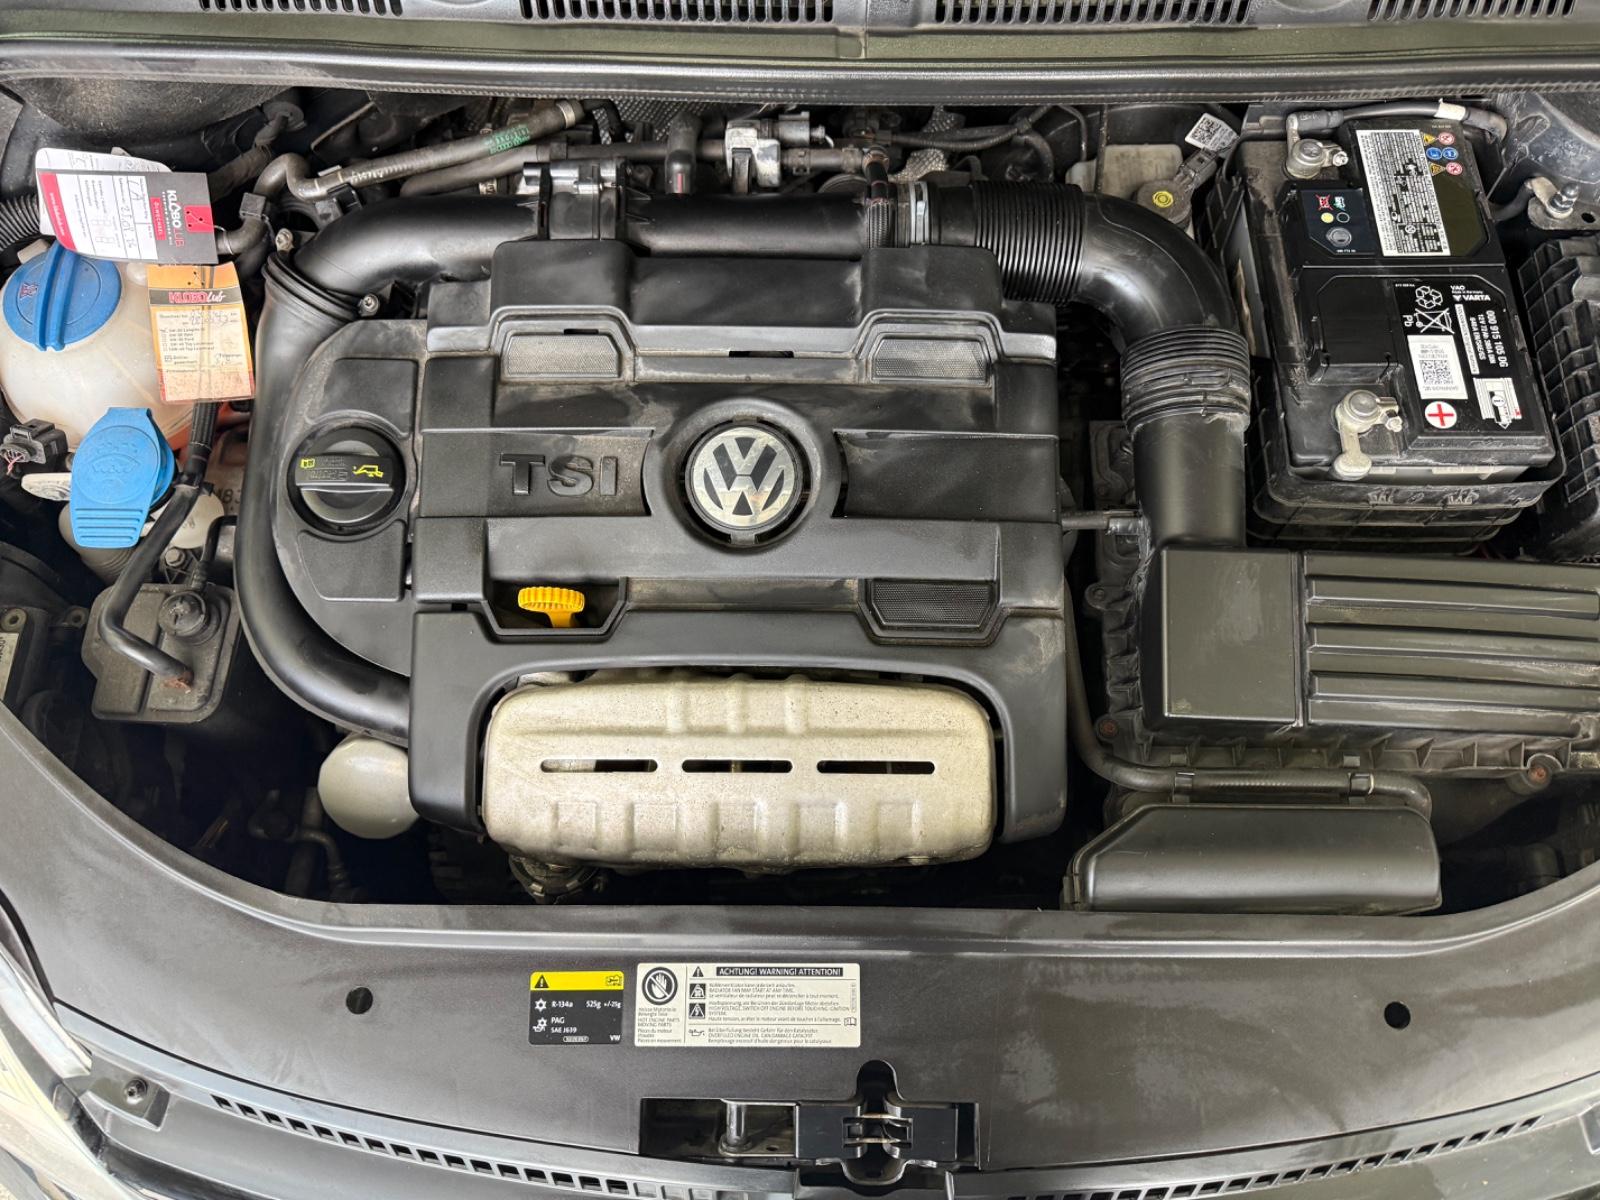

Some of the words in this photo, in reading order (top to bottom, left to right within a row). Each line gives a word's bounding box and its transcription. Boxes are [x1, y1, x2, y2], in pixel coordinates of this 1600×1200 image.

[1402, 315, 1414, 327] Pb
[1486, 310, 1498, 324] 000
[1490, 326, 1501, 339] 915
[1494, 341, 1505, 354] 105
[500, 453, 618, 497] TSI
[586, 1001, 601, 1009] 525g
